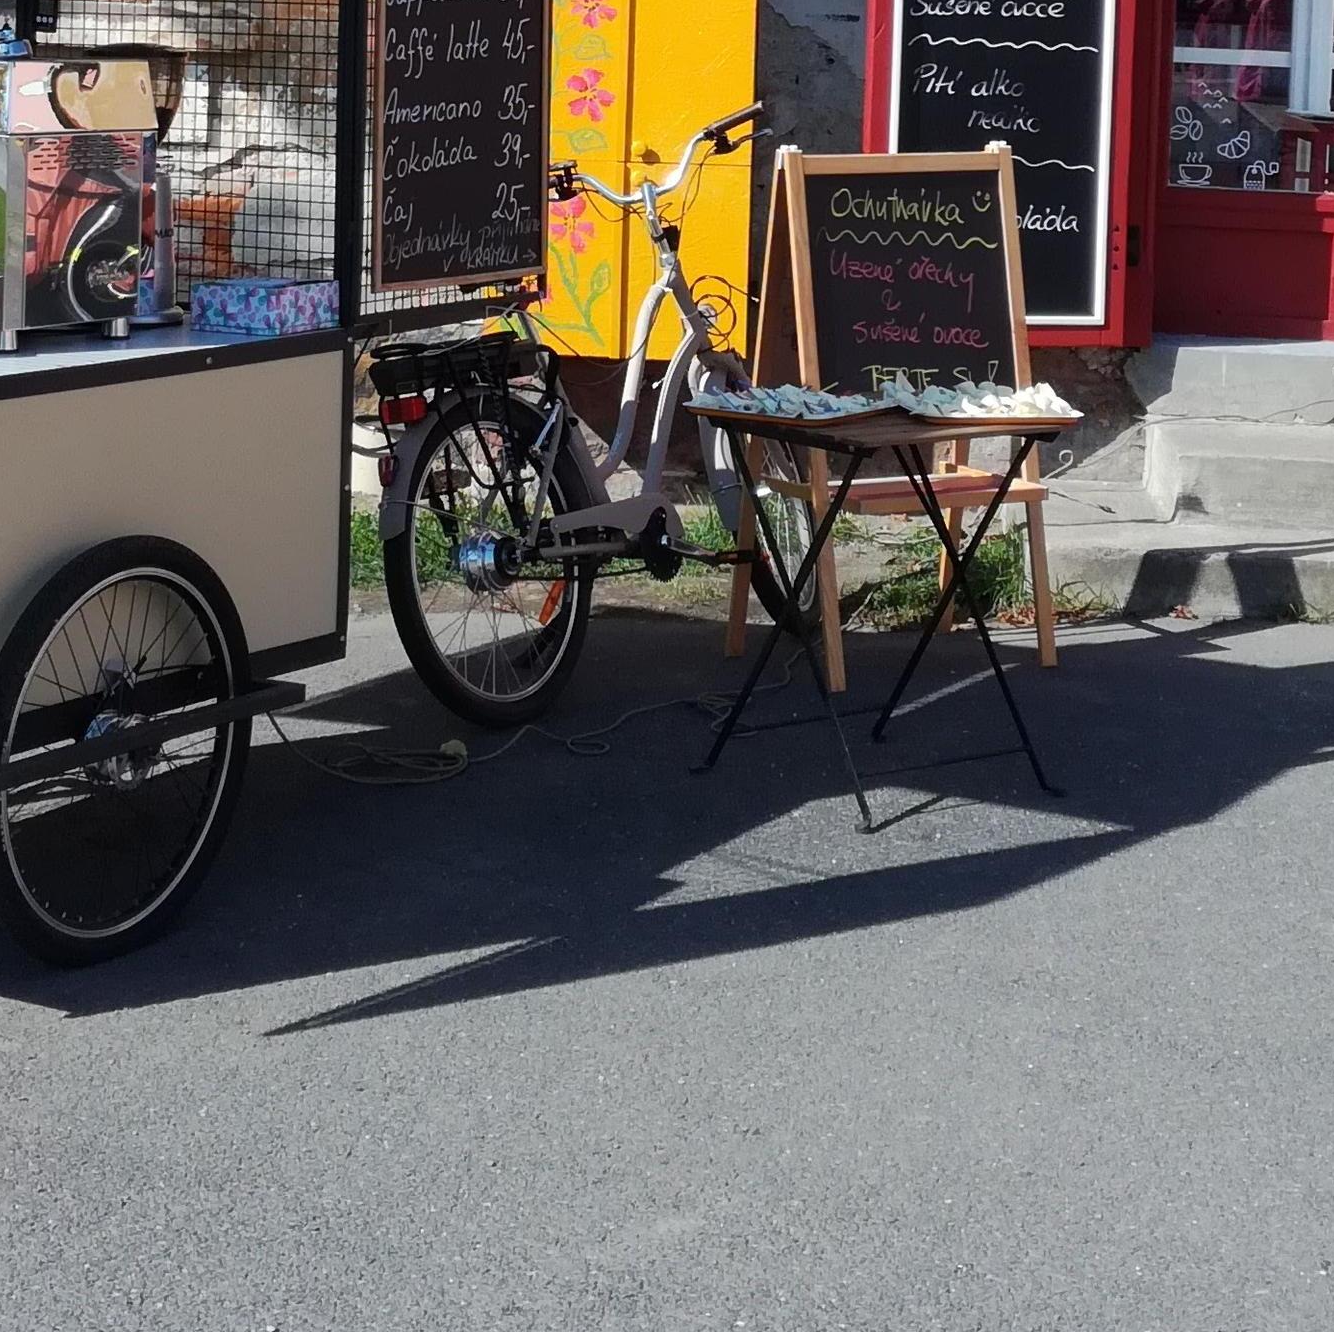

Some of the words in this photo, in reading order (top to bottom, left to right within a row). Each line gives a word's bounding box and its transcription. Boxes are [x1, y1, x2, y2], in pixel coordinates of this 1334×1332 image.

[1000, 0, 1066, 18] ovoce
[384, 27, 438, 79] Caffé
[447, 20, 489, 62] latte
[502, 18, 535, 64] 45,-
[913, 63, 963, 95] Pití
[971, 68, 1025, 97] alko
[383, 88, 482, 124] Americano
[498, 84, 535, 125] 35,-
[382, 136, 478, 181] Čokoláda
[495, 132, 530, 169] 39,-
[382, 188, 413, 232] Čaj
[492, 182, 531, 226] 25,-
[830, 249, 903, 283] Uzené
[909, 256, 974, 313] ořechy
[933, 326, 989, 348] ovoce
